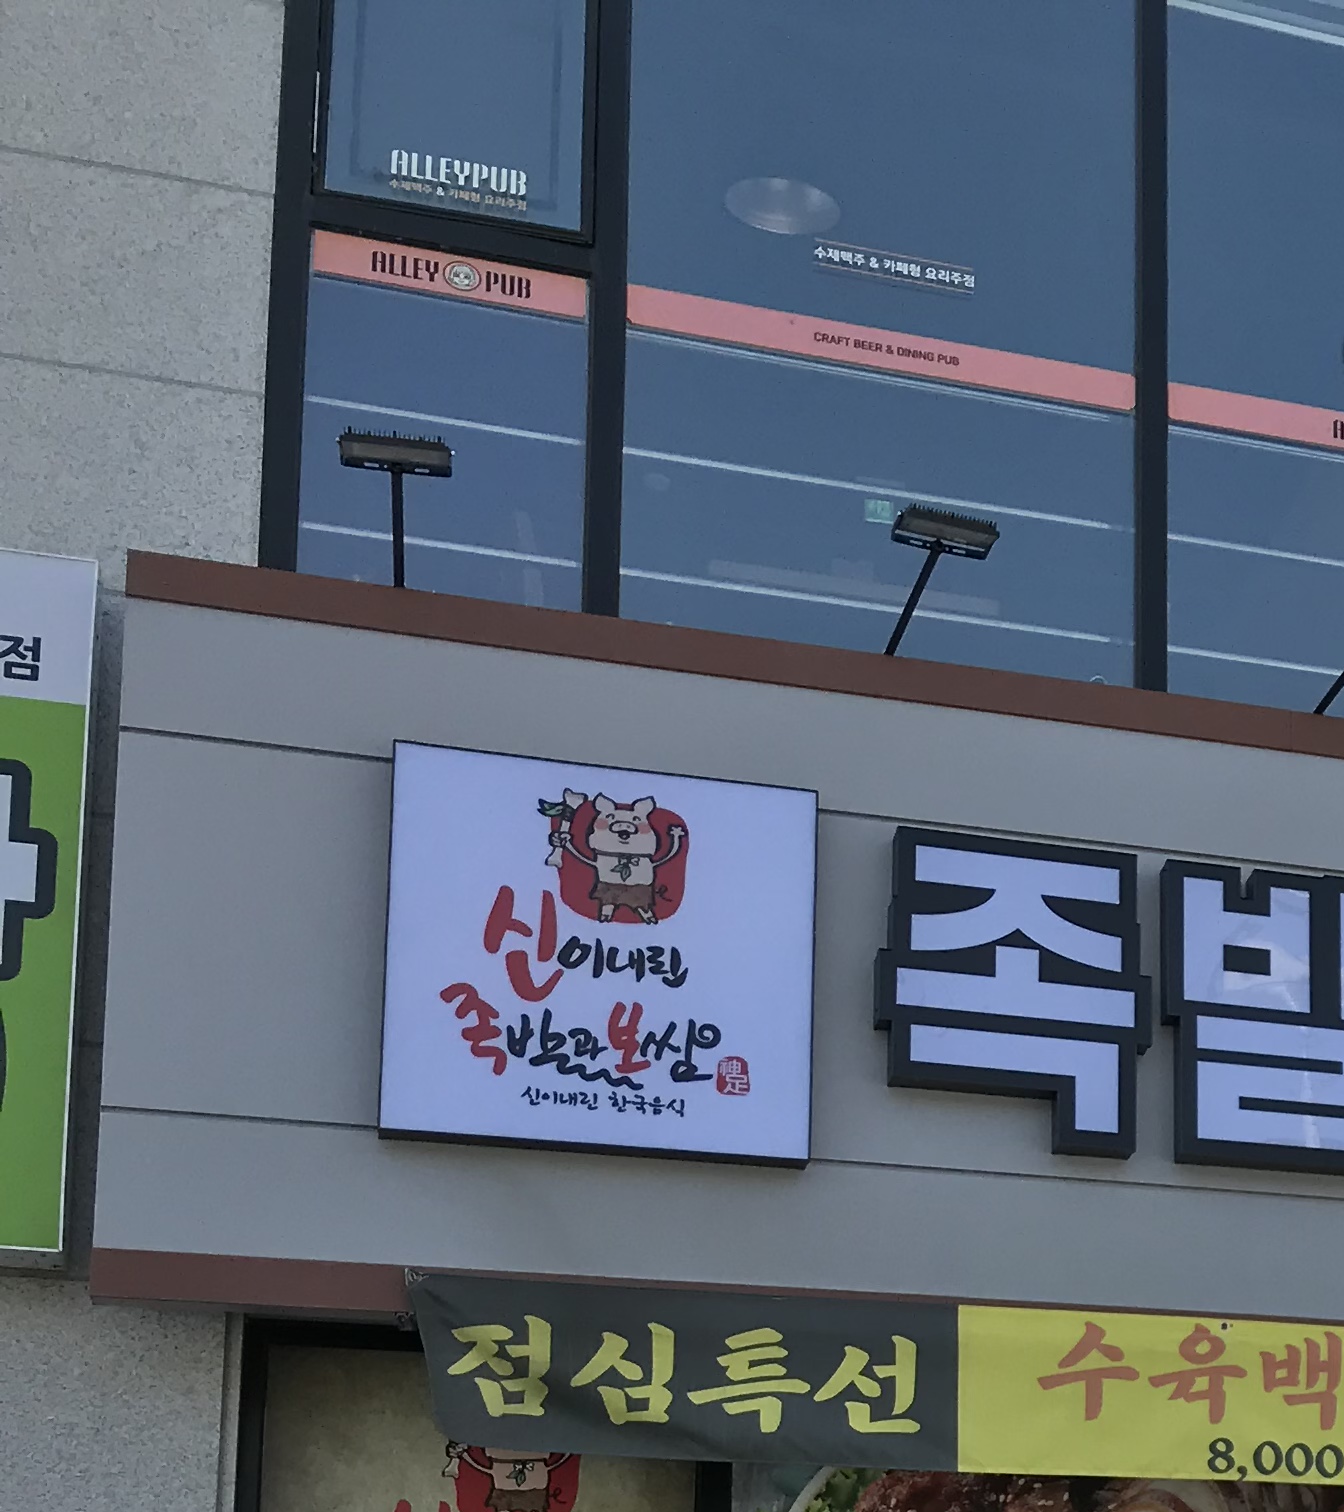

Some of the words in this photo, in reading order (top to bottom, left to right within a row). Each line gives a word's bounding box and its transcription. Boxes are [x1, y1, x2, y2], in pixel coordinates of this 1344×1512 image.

[390, 149, 527, 196] ALLEYPUB
[371, 250, 439, 282] ALLEY
[485, 270, 531, 299] PUB
[869, 257, 879, 269] &
[813, 331, 851, 347] CRAFT
[853, 338, 883, 353] BEER
[885, 344, 894, 354] &
[896, 346, 935, 362] DINING
[937, 353, 960, 366] PUB
[0, 634, 42, 681] 점
[520, 1086, 598, 1111] 신이내린
[608, 1092, 686, 1118] 한국음식
[447, 1314, 922, 1434] 점심특선
